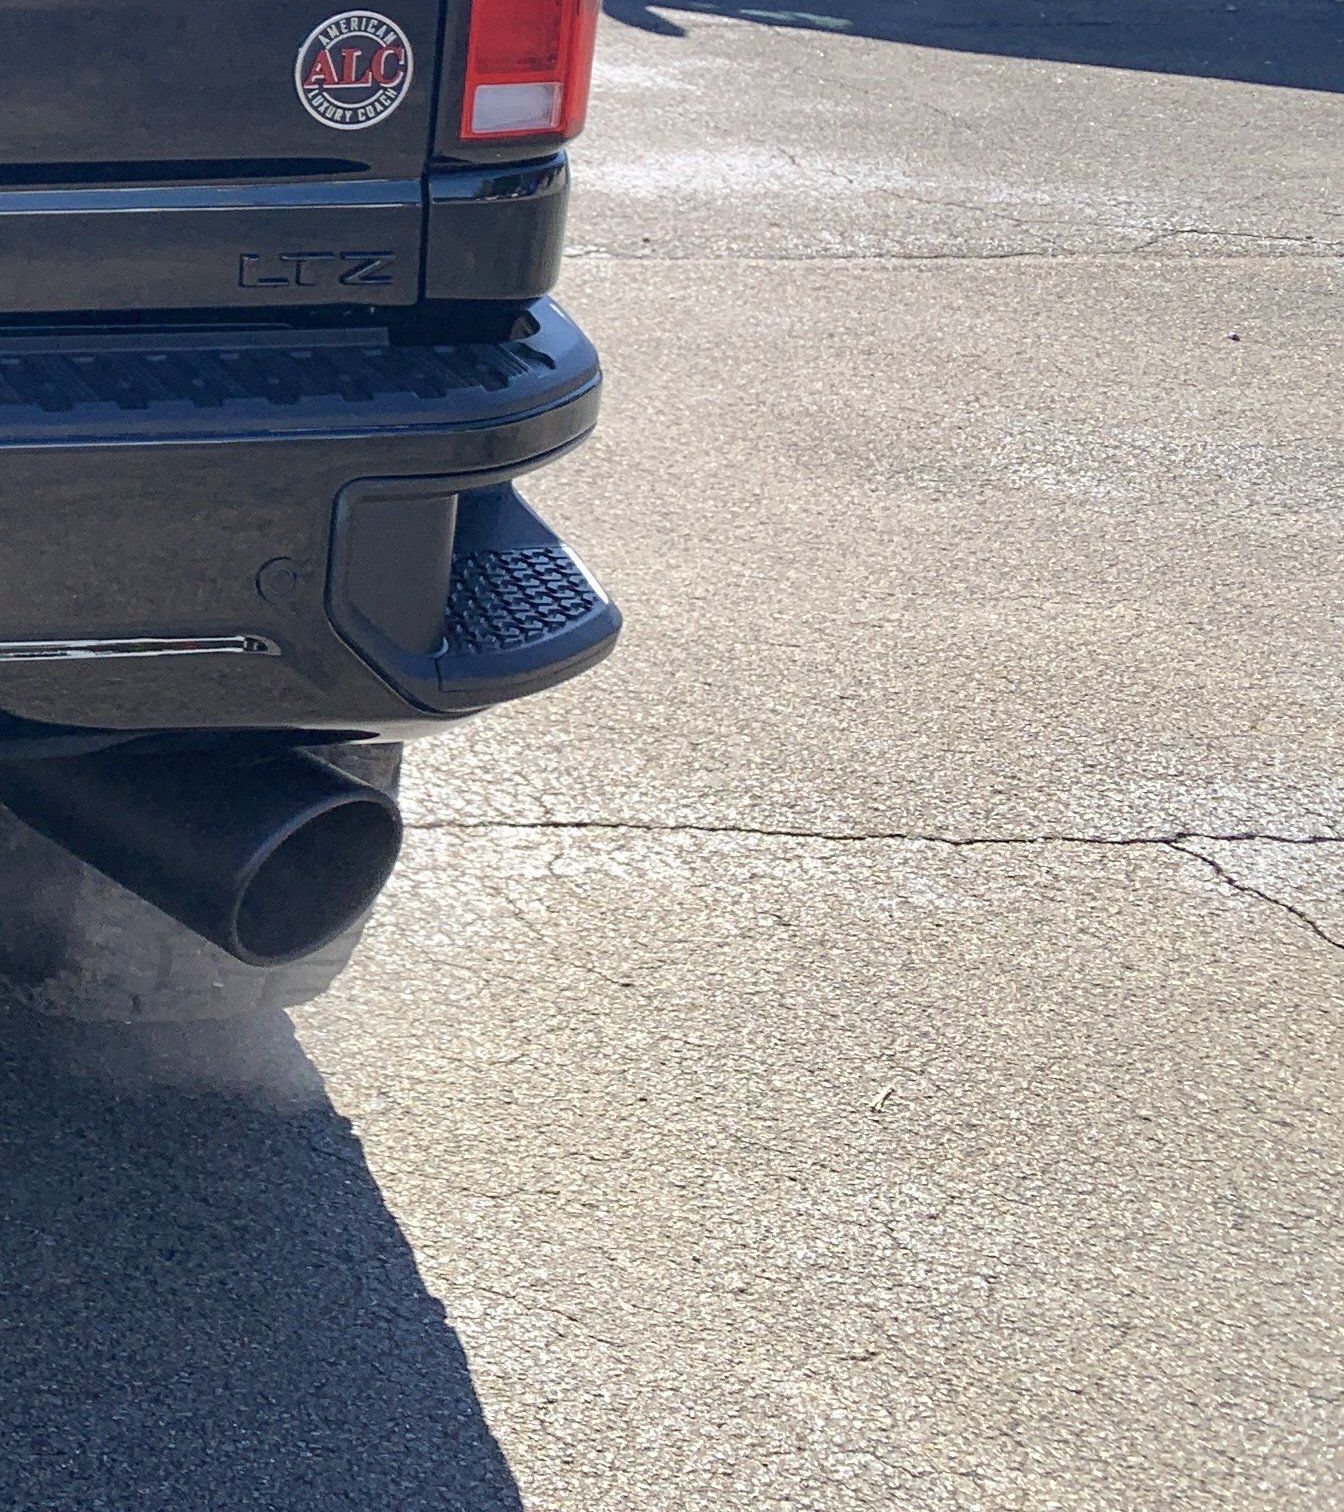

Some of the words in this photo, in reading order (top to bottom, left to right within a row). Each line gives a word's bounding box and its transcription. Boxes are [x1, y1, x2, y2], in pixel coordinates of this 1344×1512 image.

[317, 17, 397, 46] AMERICAN
[303, 45, 405, 89] ALC
[308, 89, 353, 122] LUXURY
[357, 88, 398, 122] COACH
[238, 251, 395, 288] LTZ
